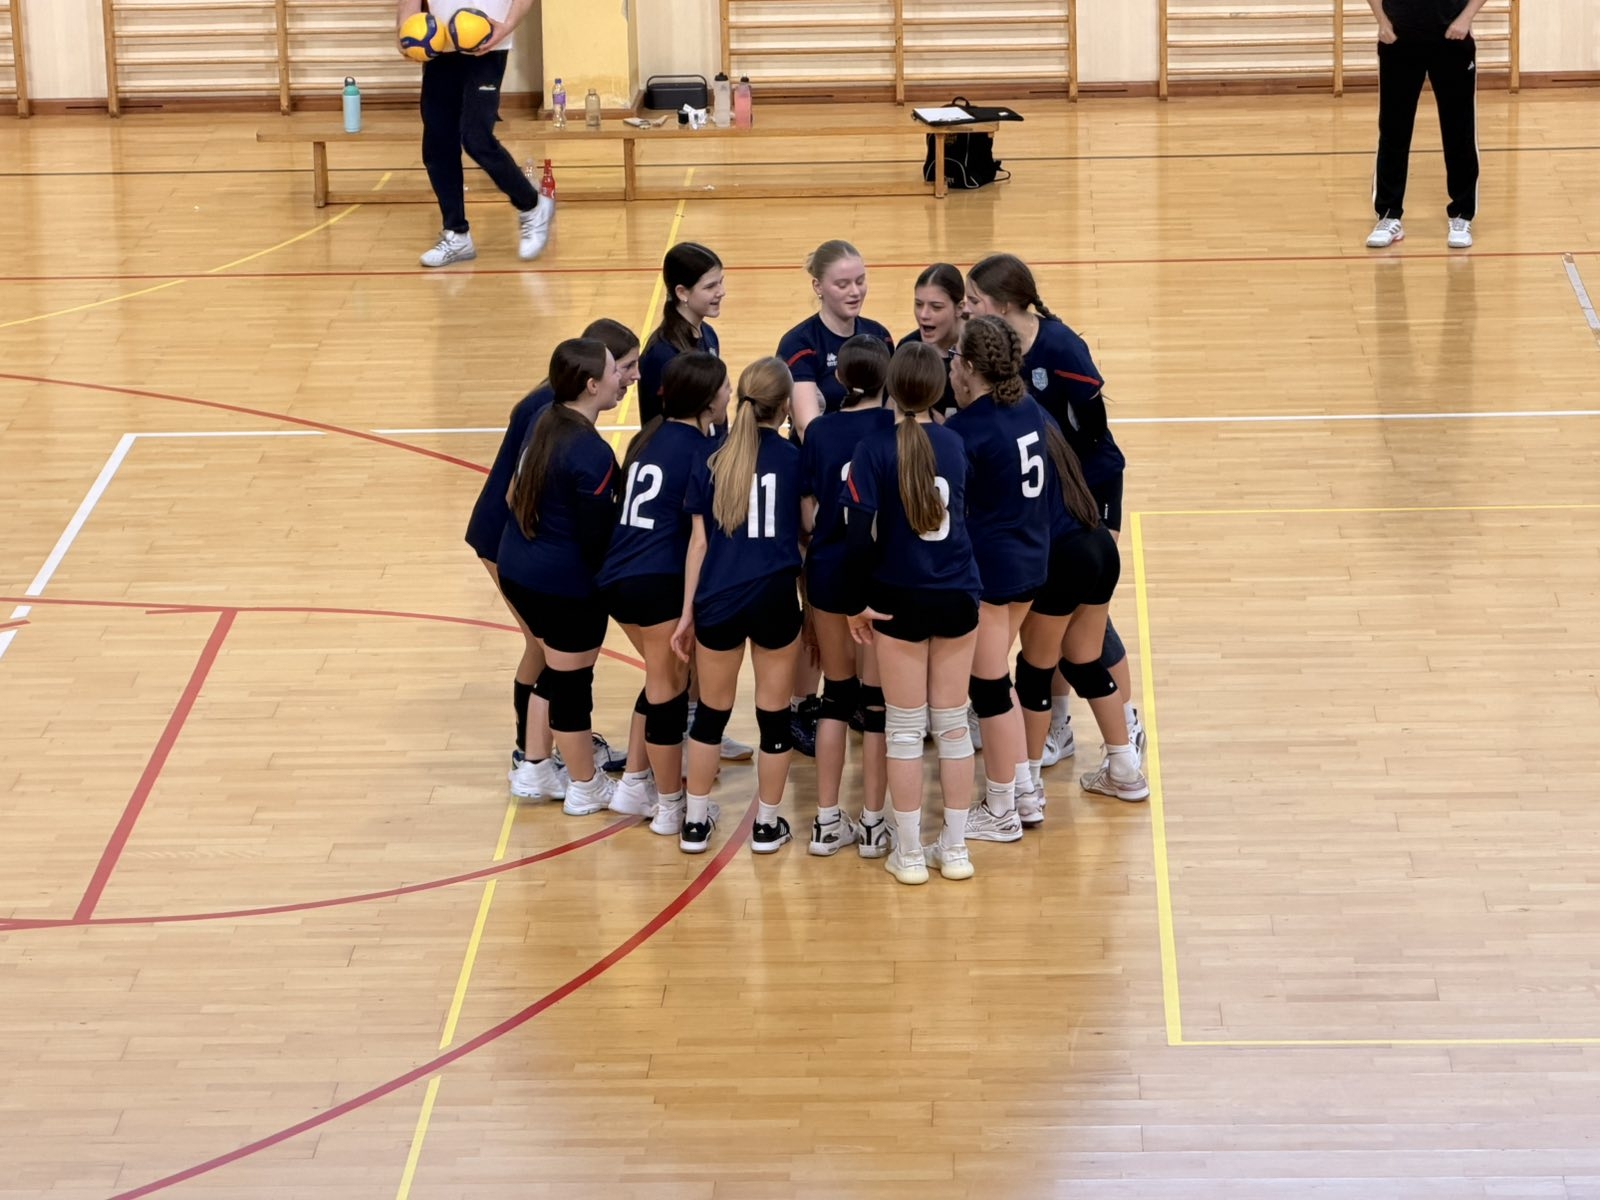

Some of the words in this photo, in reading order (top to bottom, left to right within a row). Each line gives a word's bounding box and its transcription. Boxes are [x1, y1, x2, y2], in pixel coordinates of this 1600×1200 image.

[620, 461, 663, 530] 12
[1016, 431, 1044, 498] 5
[748, 473, 776, 538] 11
